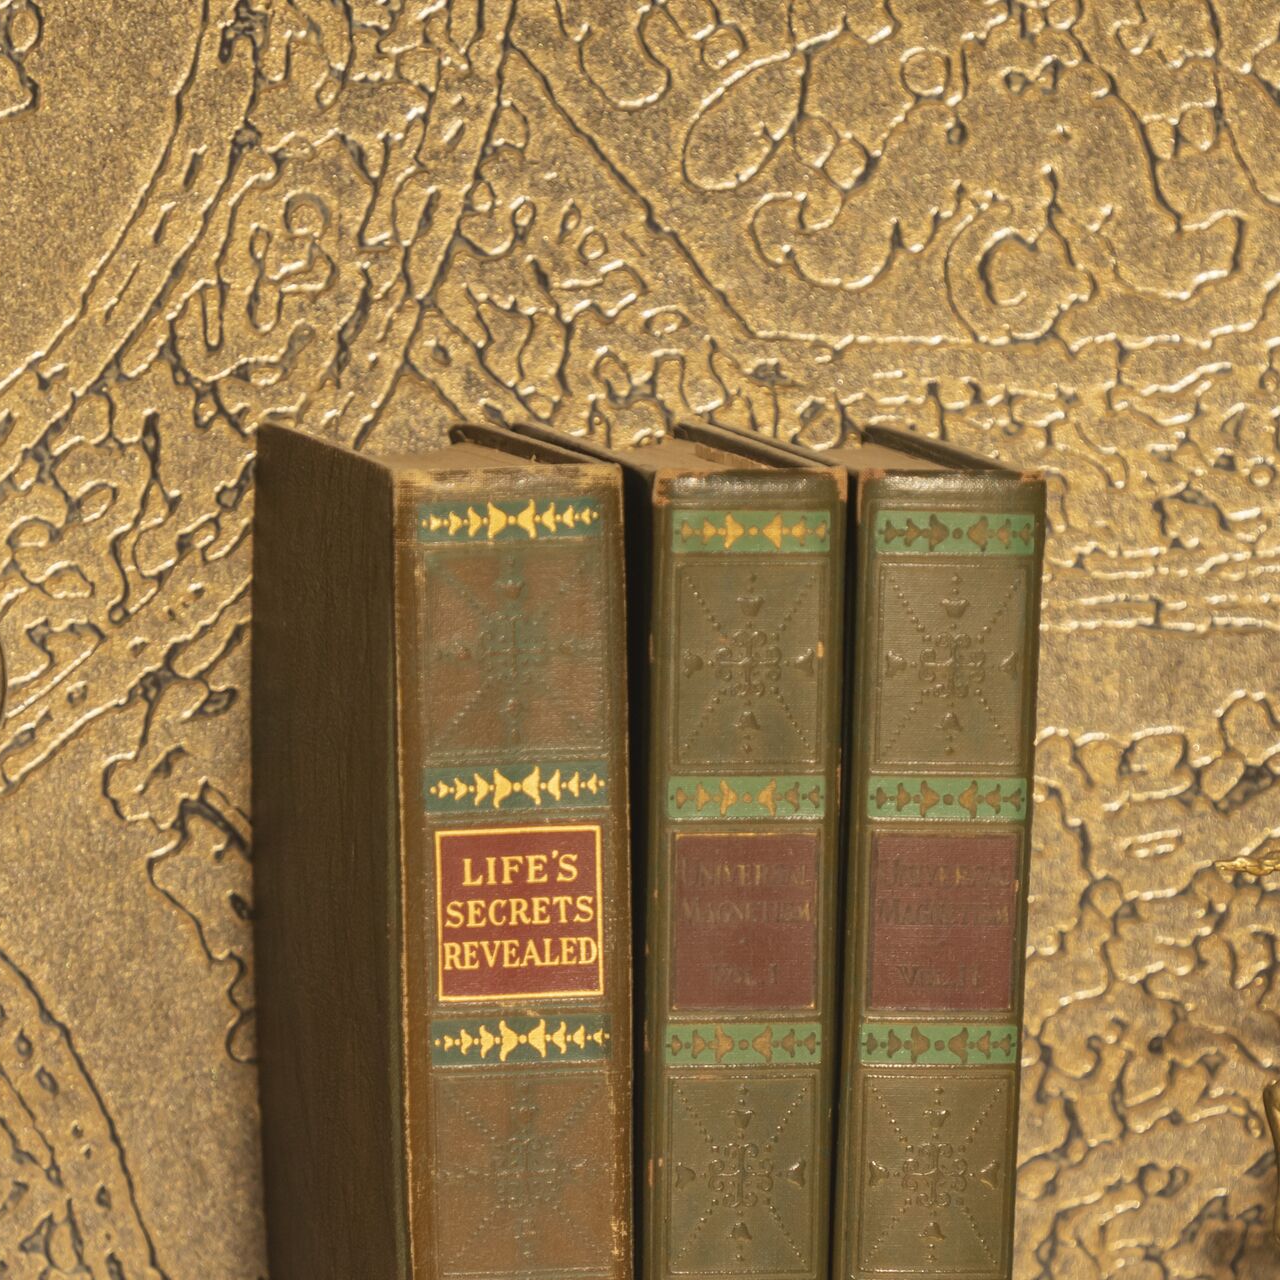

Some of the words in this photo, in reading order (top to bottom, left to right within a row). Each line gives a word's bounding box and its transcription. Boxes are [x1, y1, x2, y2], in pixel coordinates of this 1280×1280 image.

[462, 850, 579, 886] LIFE'S
[444, 895, 594, 928] SECRETS
[443, 936, 598, 970] REVEALED
